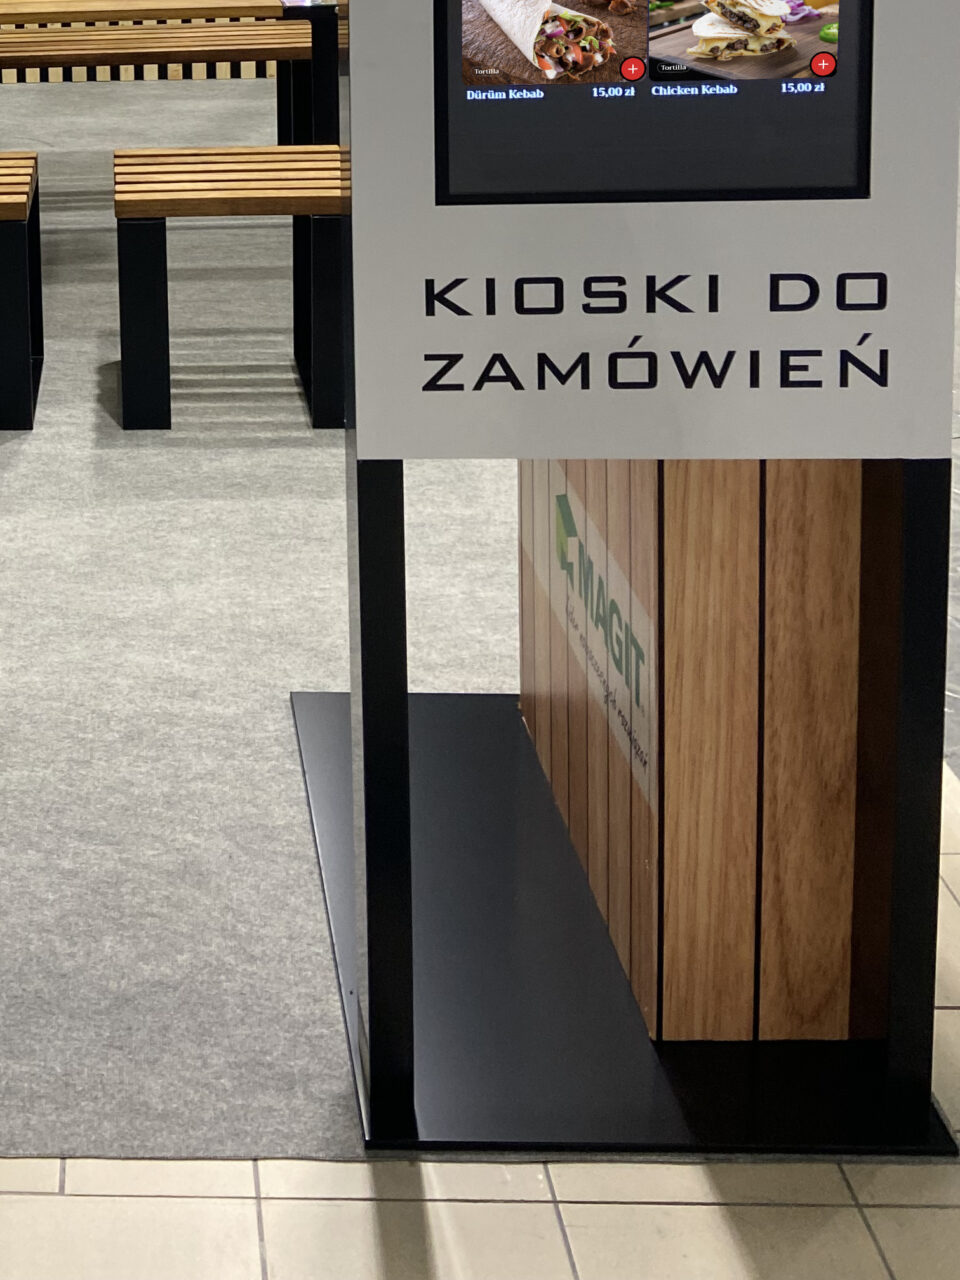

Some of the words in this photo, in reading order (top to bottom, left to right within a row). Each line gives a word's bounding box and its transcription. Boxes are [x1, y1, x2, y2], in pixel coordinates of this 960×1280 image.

[592, 87, 622, 98] 15,00
[624, 86, 635, 97] zł
[651, 84, 699, 96] Chicken
[701, 84, 738, 95] Kebab
[781, 83, 812, 94] 15,00
[814, 82, 825, 92] zł
[466, 90, 506, 100] Dürüm
[509, 89, 544, 99] Kebab
[425, 273, 719, 316] KIOSKI
[769, 272, 887, 313] DO
[422, 332, 889, 392] ZAMÓWIEŃ
[578, 537, 645, 708] MAGIT
